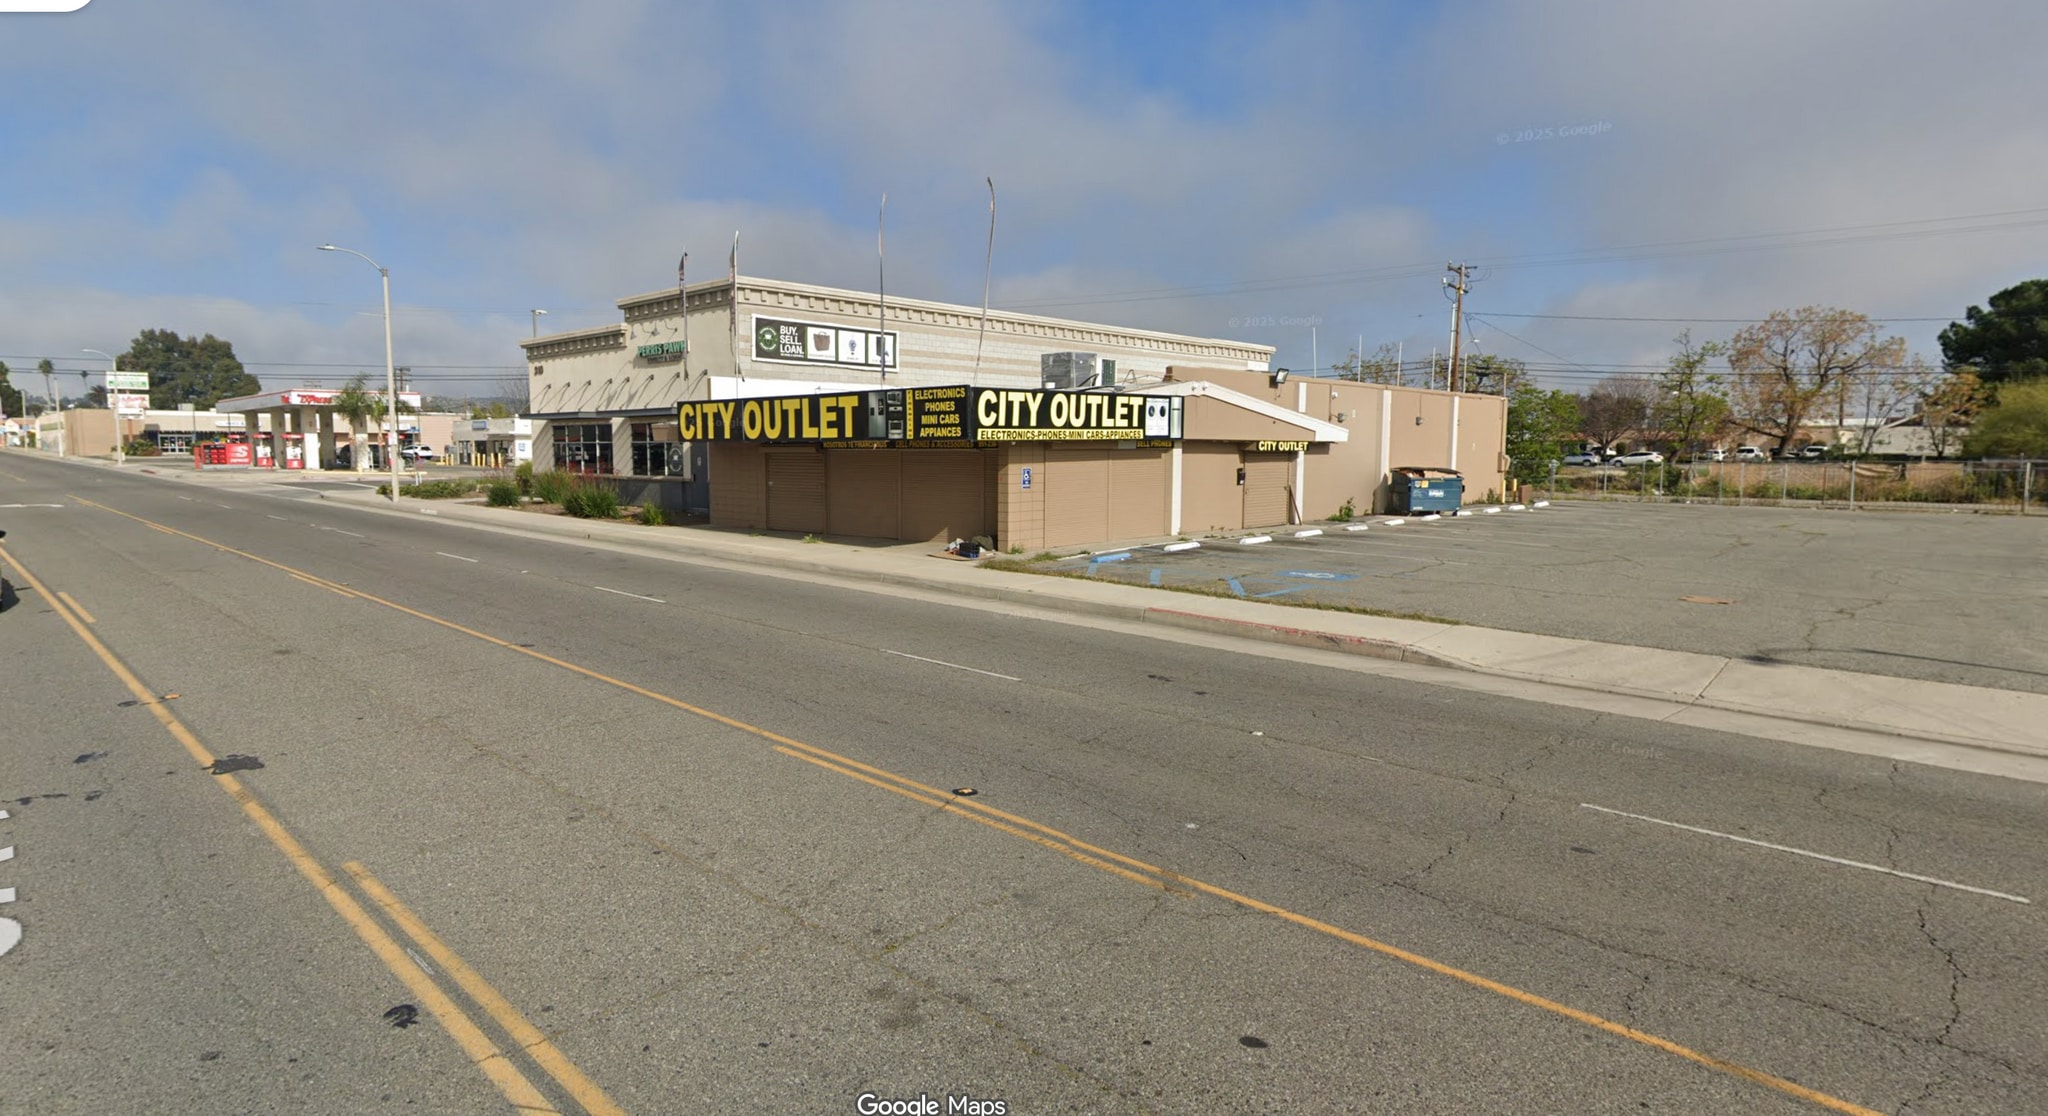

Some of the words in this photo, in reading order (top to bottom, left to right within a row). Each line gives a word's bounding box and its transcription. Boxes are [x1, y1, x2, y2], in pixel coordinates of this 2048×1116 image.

[779, 325, 798, 336] BUY.
[779, 334, 802, 345] SELL.
[779, 343, 805, 355] LOAN.
[914, 387, 966, 400] ELECTRONICS
[924, 401, 956, 412] PHONES
[977, 389, 1044, 427] CITY
[1049, 392, 1144, 428] OUTLET
[680, 401, 736, 440] CITY
[743, 395, 859, 441] OUTLET
[921, 414, 938, 425] MINI
[939, 413, 960, 425] CARS
[919, 427, 962, 438] APPIANCES
[1258, 440, 1278, 451] CITY
[1278, 441, 1309, 451] OUTLET
